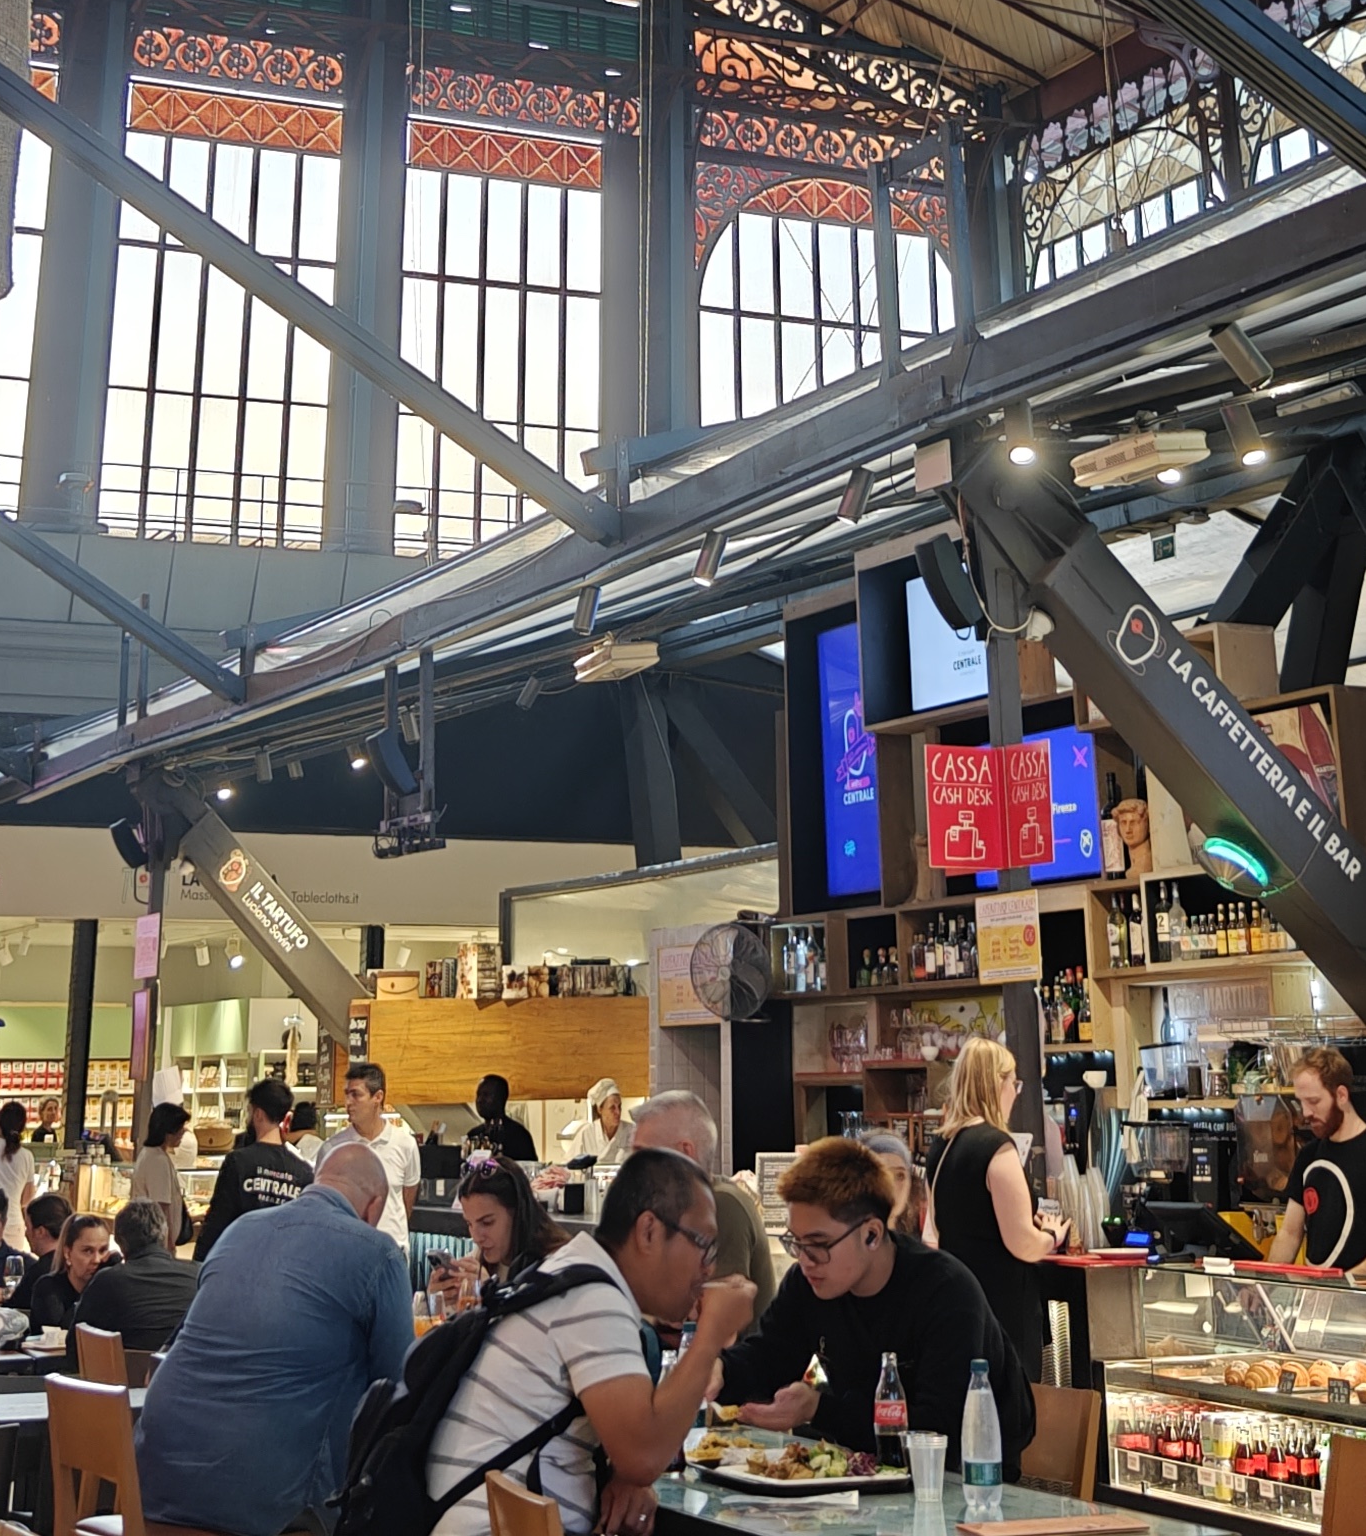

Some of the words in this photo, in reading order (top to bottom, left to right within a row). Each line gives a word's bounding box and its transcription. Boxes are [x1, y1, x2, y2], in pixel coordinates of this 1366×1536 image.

[953, 655, 982, 671] CENTRALE
[931, 752, 993, 784] CASSA
[1010, 747, 1047, 782] CASSA
[1167, 648, 1193, 683] LA
[1191, 676, 1295, 808] CAFFETTERIA
[1294, 798, 1312, 822] E
[1307, 813, 1328, 842] IL
[1324, 833, 1362, 881] BAR
[843, 787, 874, 805] CENTRALE
[933, 785, 963, 805] CASH
[967, 787, 994, 806] DESK
[1011, 784, 1030, 804] CASH
[1032, 781, 1047, 801] DESK
[291, 891, 359, 905] Tablecloths.it
[241, 892, 271, 928] Luciano
[269, 924, 295, 954] Savini
[249, 881, 262, 898] IL
[260, 893, 309, 950] TARTUFO
[242, 1177, 302, 1199] CENTRALE
